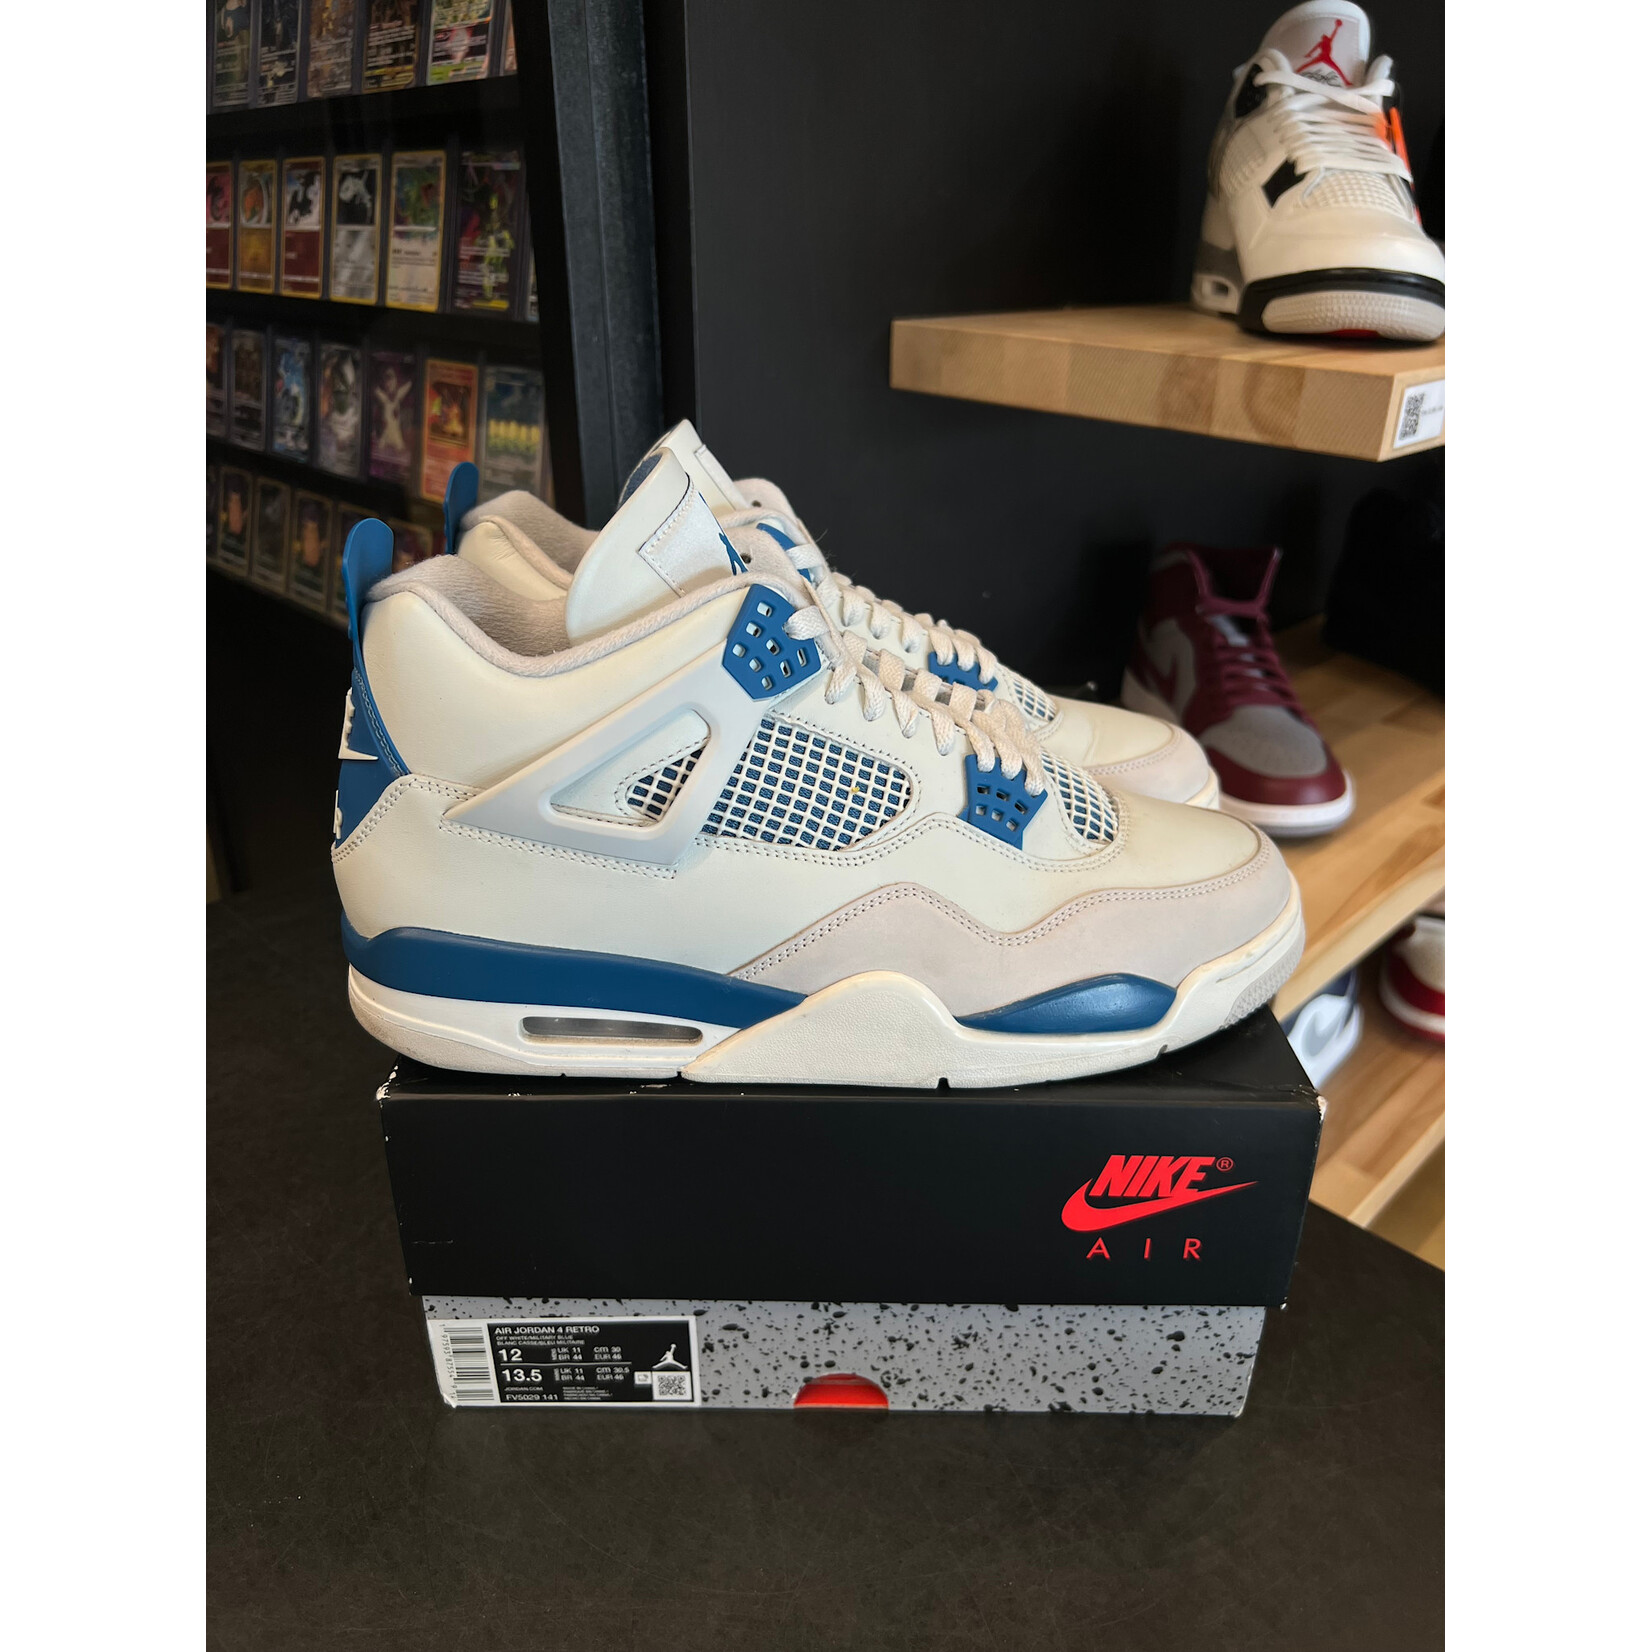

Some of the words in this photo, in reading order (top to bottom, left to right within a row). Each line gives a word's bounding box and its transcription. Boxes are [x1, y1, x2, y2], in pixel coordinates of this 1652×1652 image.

[1088, 1154, 1216, 1198] NIKE
[1086, 1237, 1202, 1260] AIR
[495, 1327, 512, 1335] AIR
[514, 1326, 555, 1334] JORDAN
[556, 1326, 563, 1334] 4
[565, 1325, 600, 1333] RETRO
[498, 1348, 523, 1361] 12
[502, 1369, 543, 1382] 13.5
